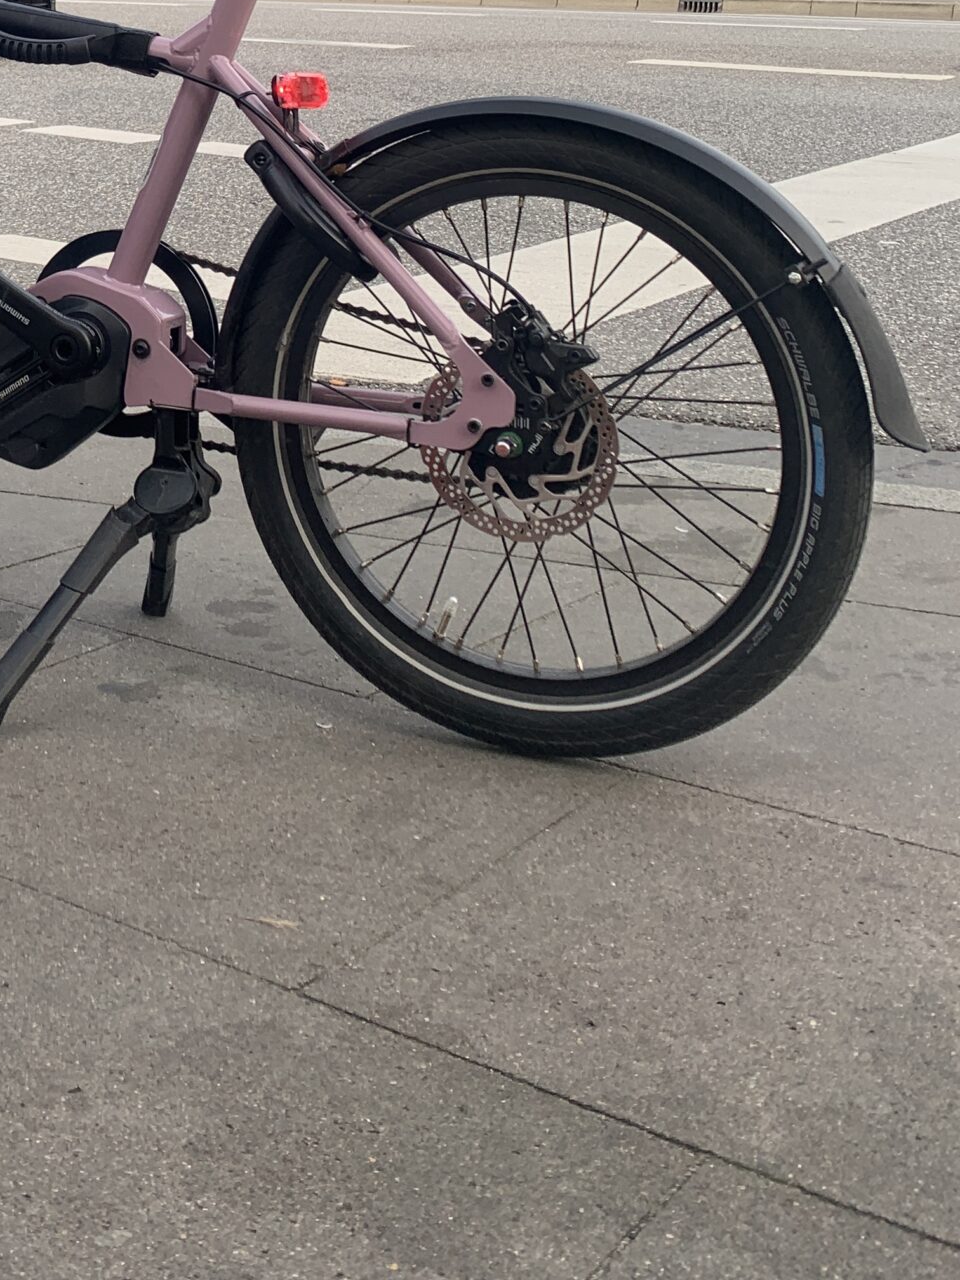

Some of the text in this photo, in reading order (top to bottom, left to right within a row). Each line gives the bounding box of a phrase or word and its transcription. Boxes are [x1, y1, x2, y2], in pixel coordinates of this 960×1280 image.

[776, 317, 821, 420] SCHWALBE
[772, 503, 823, 622] BIG APPLE PLUS
